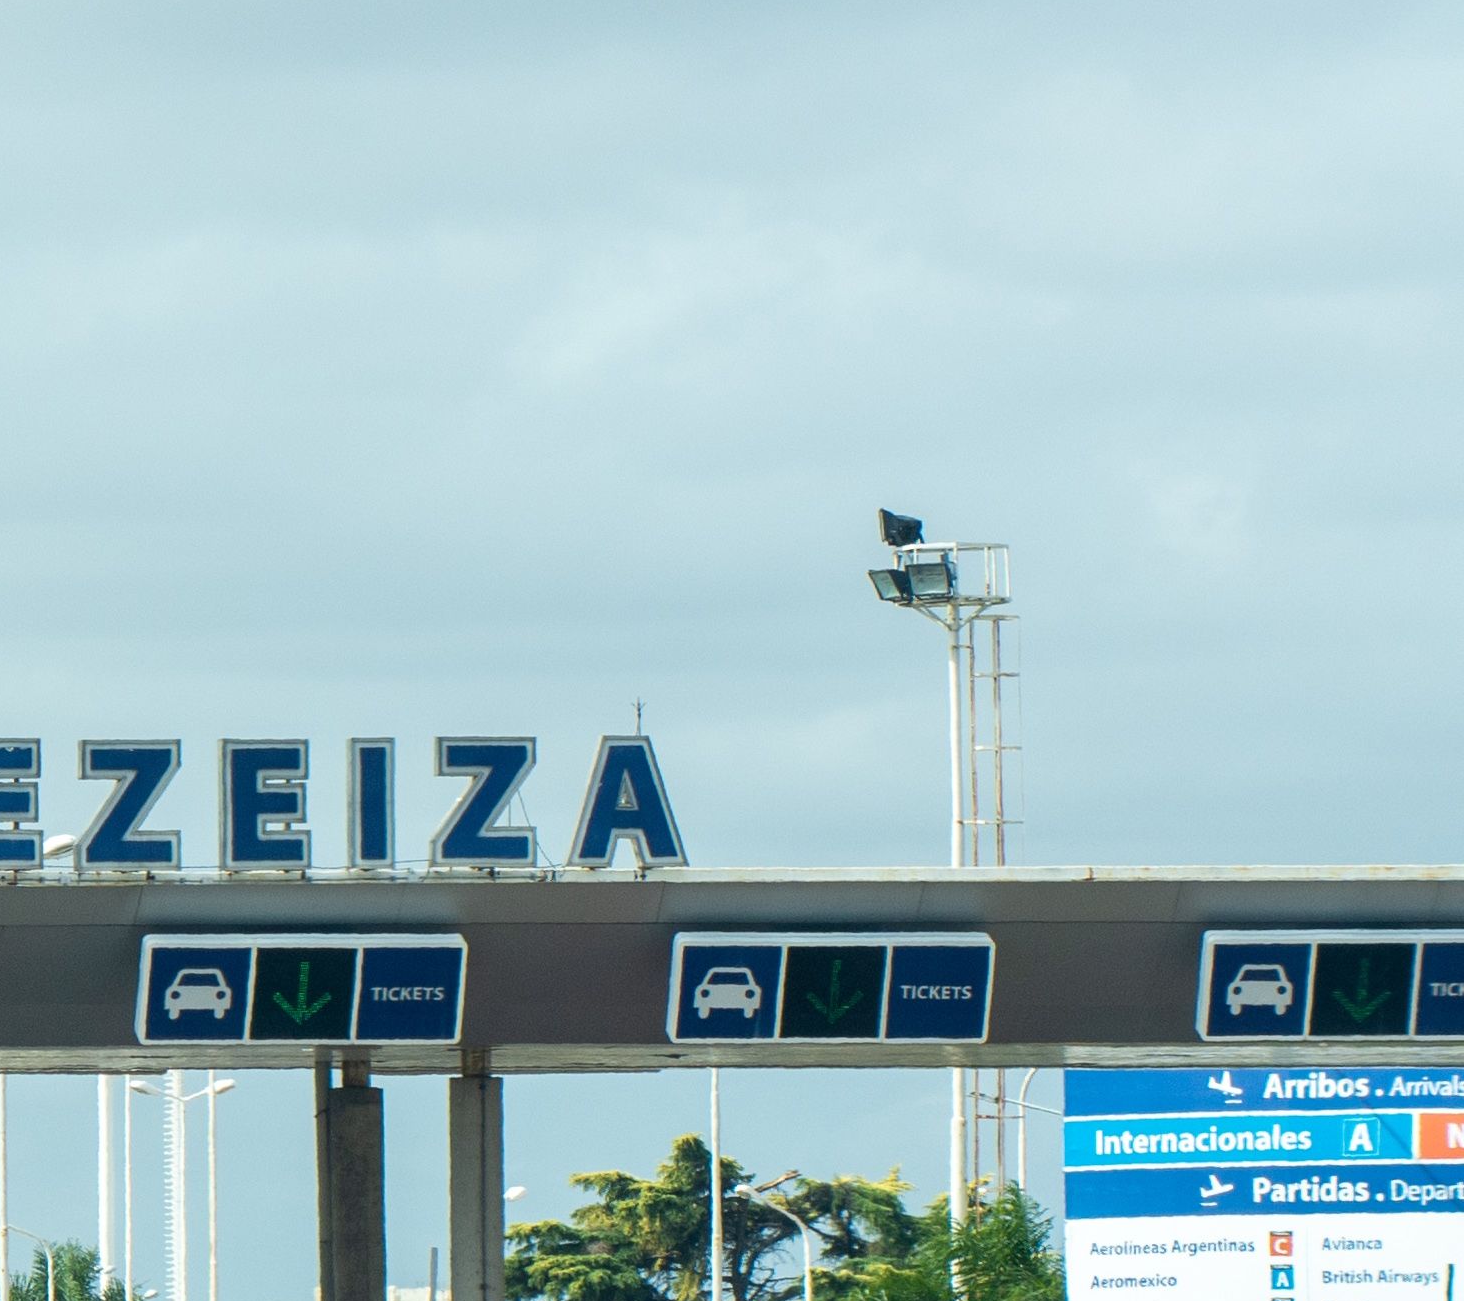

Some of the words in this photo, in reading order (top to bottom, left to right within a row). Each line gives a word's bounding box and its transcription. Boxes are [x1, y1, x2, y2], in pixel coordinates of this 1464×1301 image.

[371, 988, 444, 1001] TICKETS
[901, 987, 972, 999] TICKETS
[1262, 1072, 1370, 1099] Arribos
[1095, 1124, 1313, 1155] Internacionales
[1348, 1123, 1374, 1152] A
[1252, 1175, 1370, 1203] Partidas
[1171, 1238, 1256, 1256] Argentinas
[1274, 1238, 1288, 1254] C
[1322, 1237, 1383, 1251] Avianca
[1090, 1274, 1178, 1289] Aeromexico
[1276, 1271, 1290, 1288] A
[1322, 1269, 1373, 1284] British
[1377, 1269, 1440, 1286] Airways
